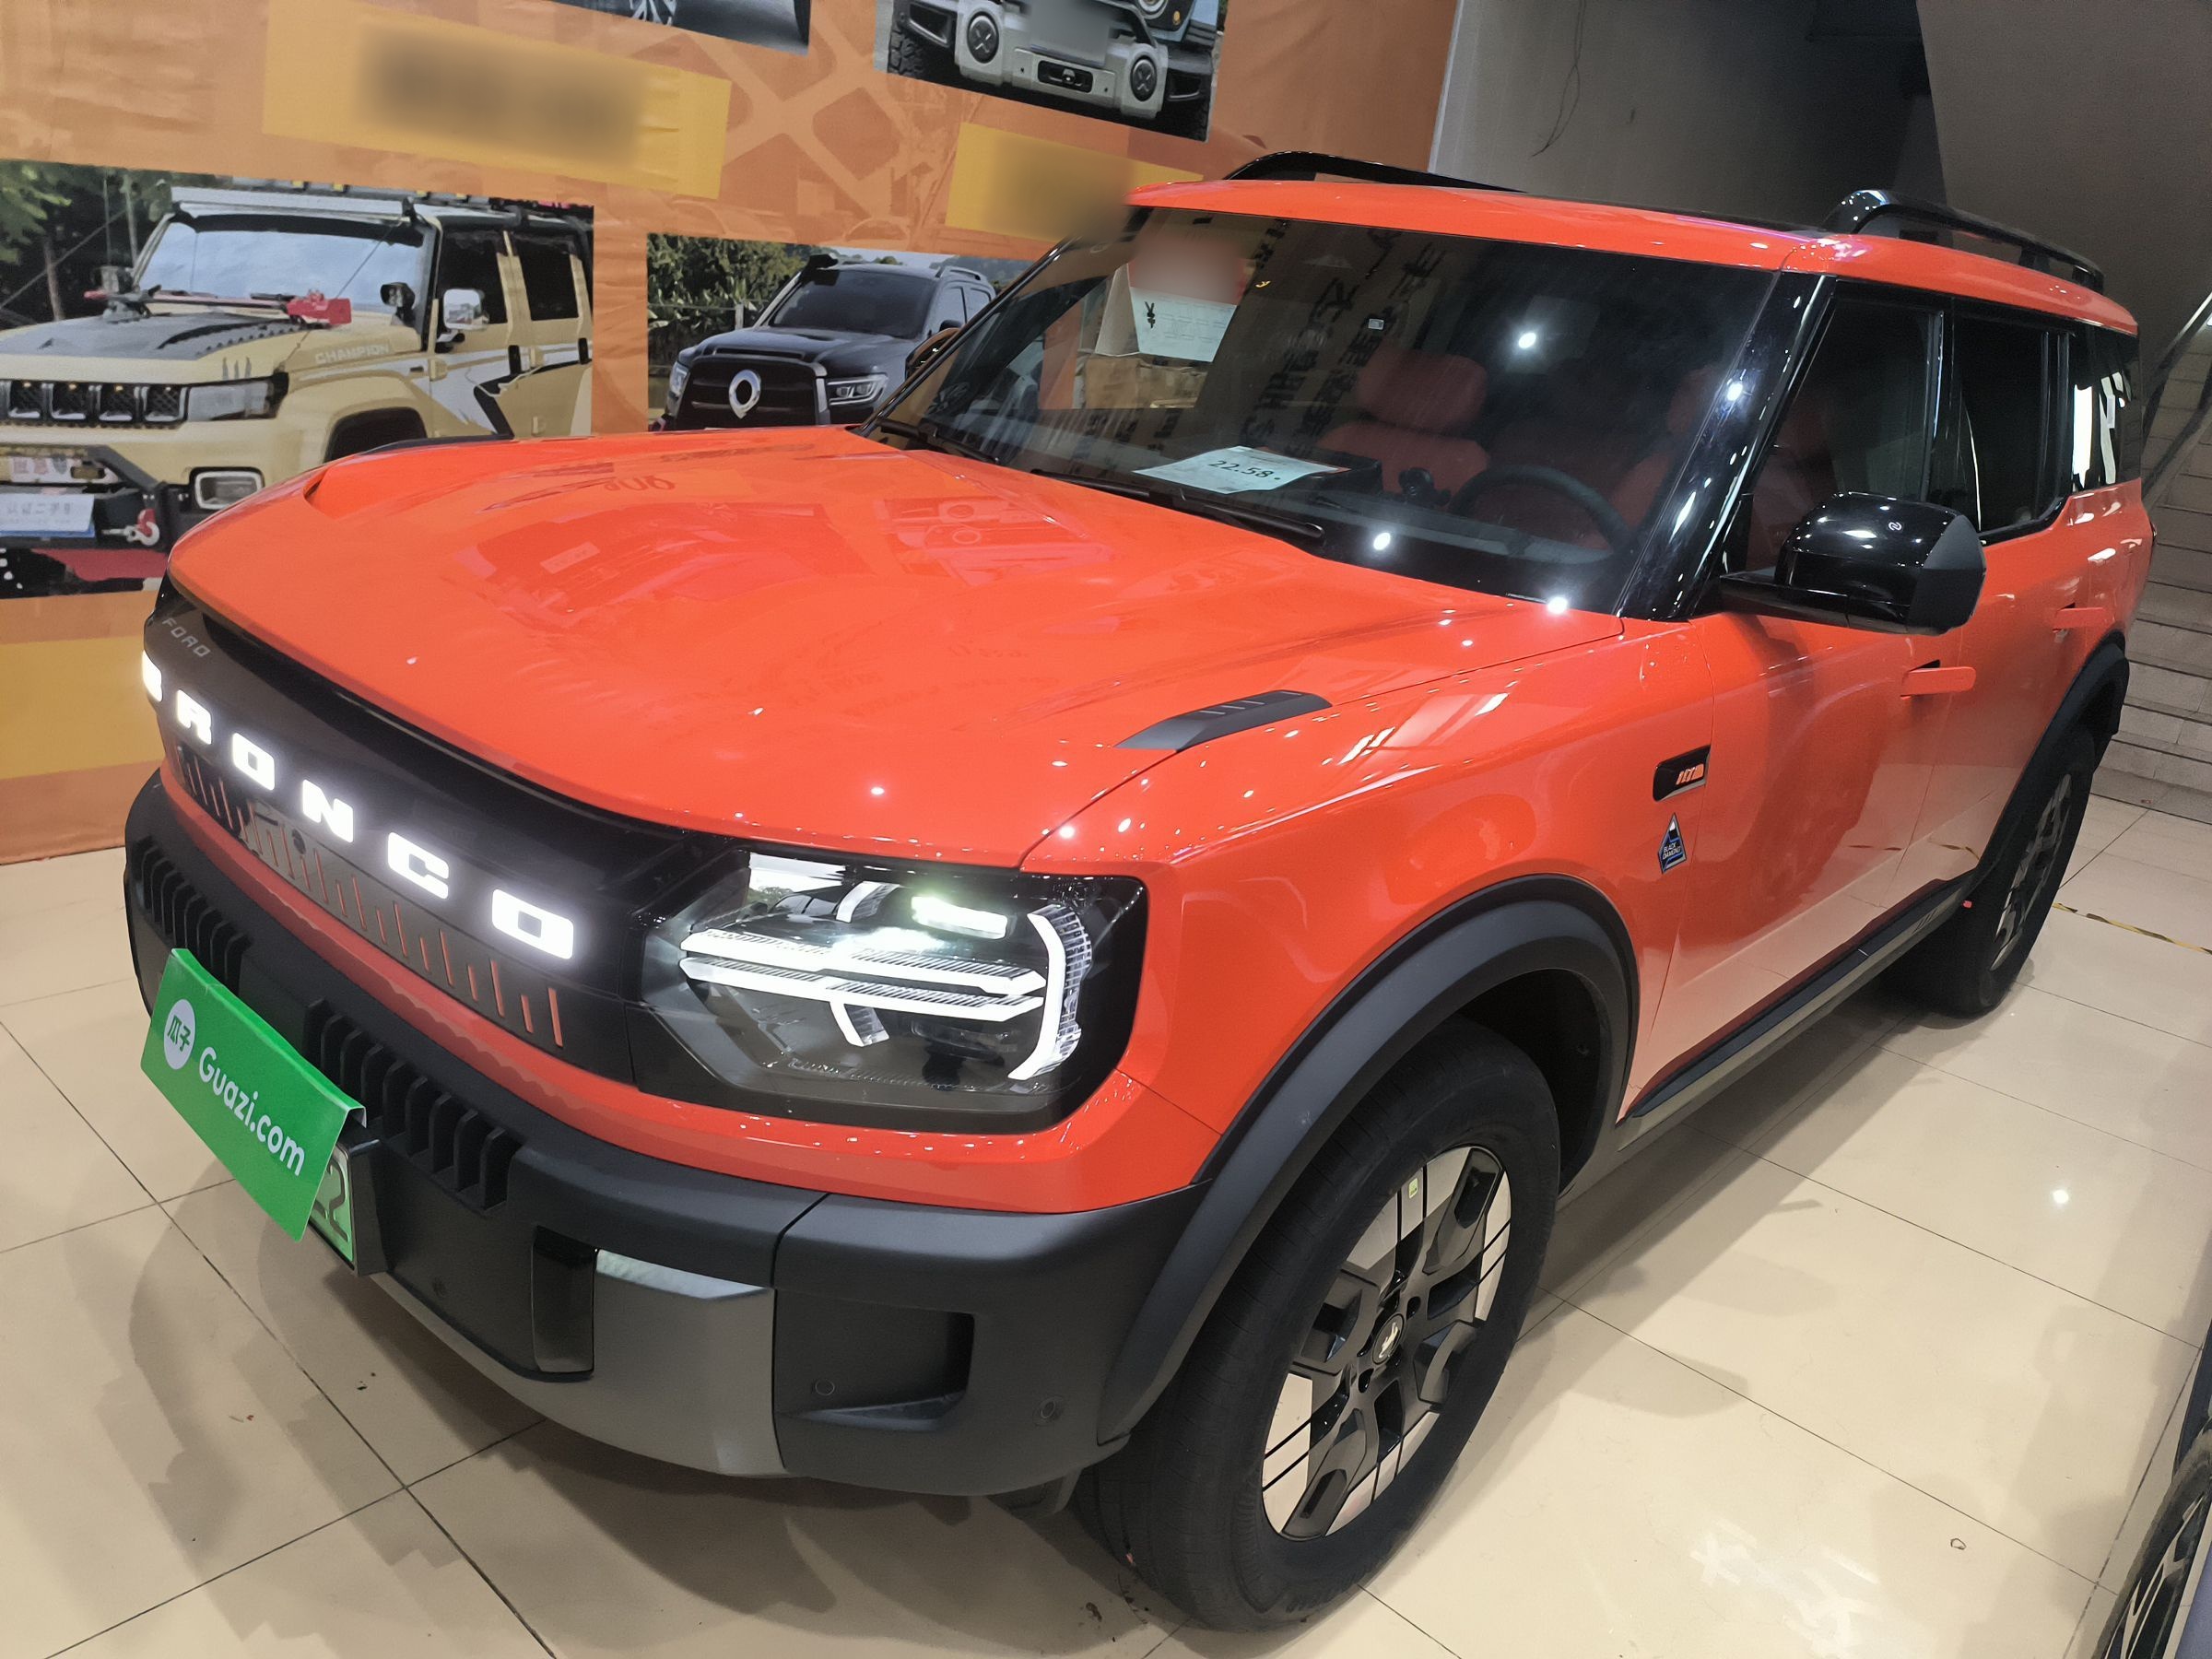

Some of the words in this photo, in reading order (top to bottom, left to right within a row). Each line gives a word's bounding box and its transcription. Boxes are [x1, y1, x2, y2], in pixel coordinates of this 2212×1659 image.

[161, 617, 211, 657] FORD
[1662, 845, 1682, 860] DIAMOND
[1663, 841, 1677, 853] BLACK
[167, 1014, 192, 1053] 瓜子
[198, 1046, 305, 1176] Guazi.com
